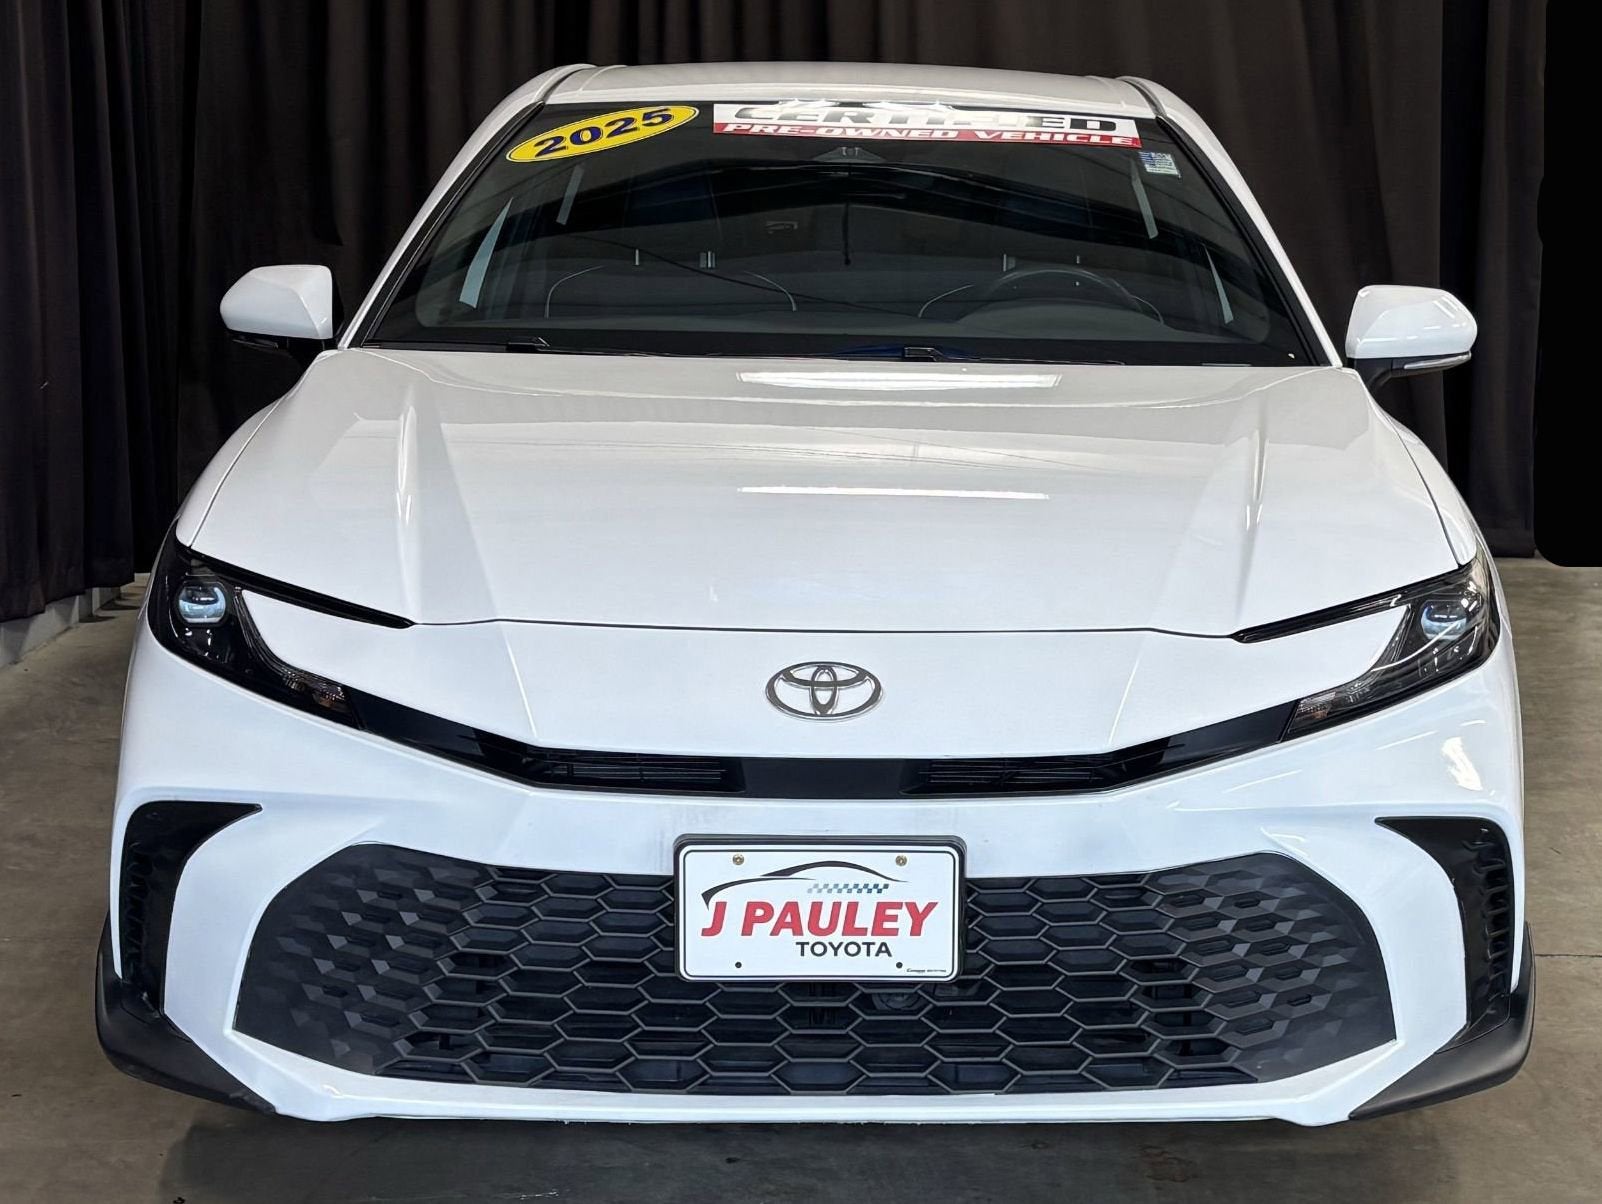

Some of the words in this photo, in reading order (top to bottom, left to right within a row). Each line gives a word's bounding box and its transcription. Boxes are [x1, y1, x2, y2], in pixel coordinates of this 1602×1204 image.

[734, 106, 1117, 132] CERTIED
[533, 108, 675, 158] 2025
[723, 123, 958, 139] PRE-OWNED
[974, 130, 1135, 145] VEHICLE
[701, 901, 727, 937] J
[740, 901, 939, 937] PAULEY
[795, 941, 893, 958] TOYOTA
